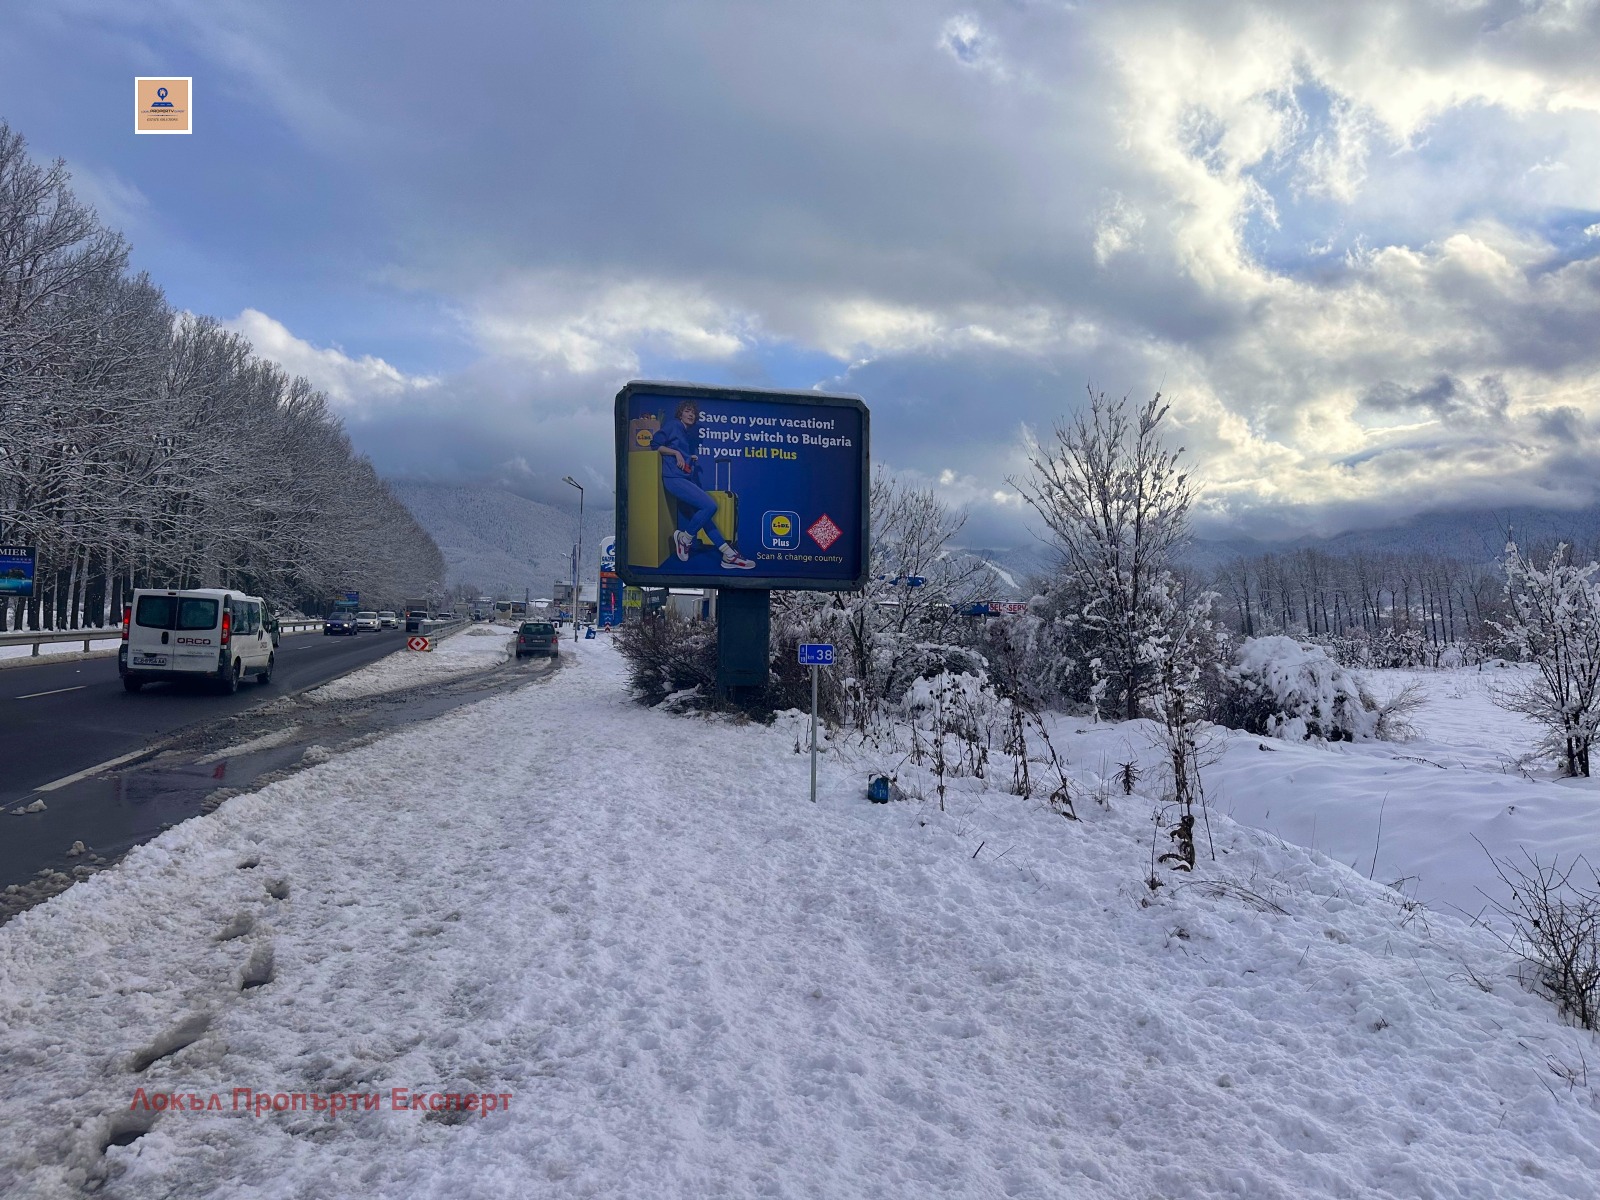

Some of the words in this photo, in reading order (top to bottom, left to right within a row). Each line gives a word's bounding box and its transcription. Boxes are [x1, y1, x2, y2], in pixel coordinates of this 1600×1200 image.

[698, 411, 728, 423] Save
[730, 415, 746, 425] on
[749, 416, 777, 427] your
[779, 418, 835, 430] vacation!
[698, 428, 742, 442] Simply
[744, 431, 784, 443] switch
[786, 433, 799, 444] to
[801, 433, 852, 448] Bulgaria
[698, 444, 711, 456] in
[713, 447, 742, 458] your
[744, 446, 768, 459] Lidl
[770, 448, 797, 460] Plus
[772, 538, 790, 547] Plus
[756, 551, 775, 560] Scan
[776, 552, 783, 560] &
[784, 552, 813, 562] change
[814, 555, 843, 563] country
[177, 637, 211, 645] ORCO
[816, 649, 833, 661] 38
